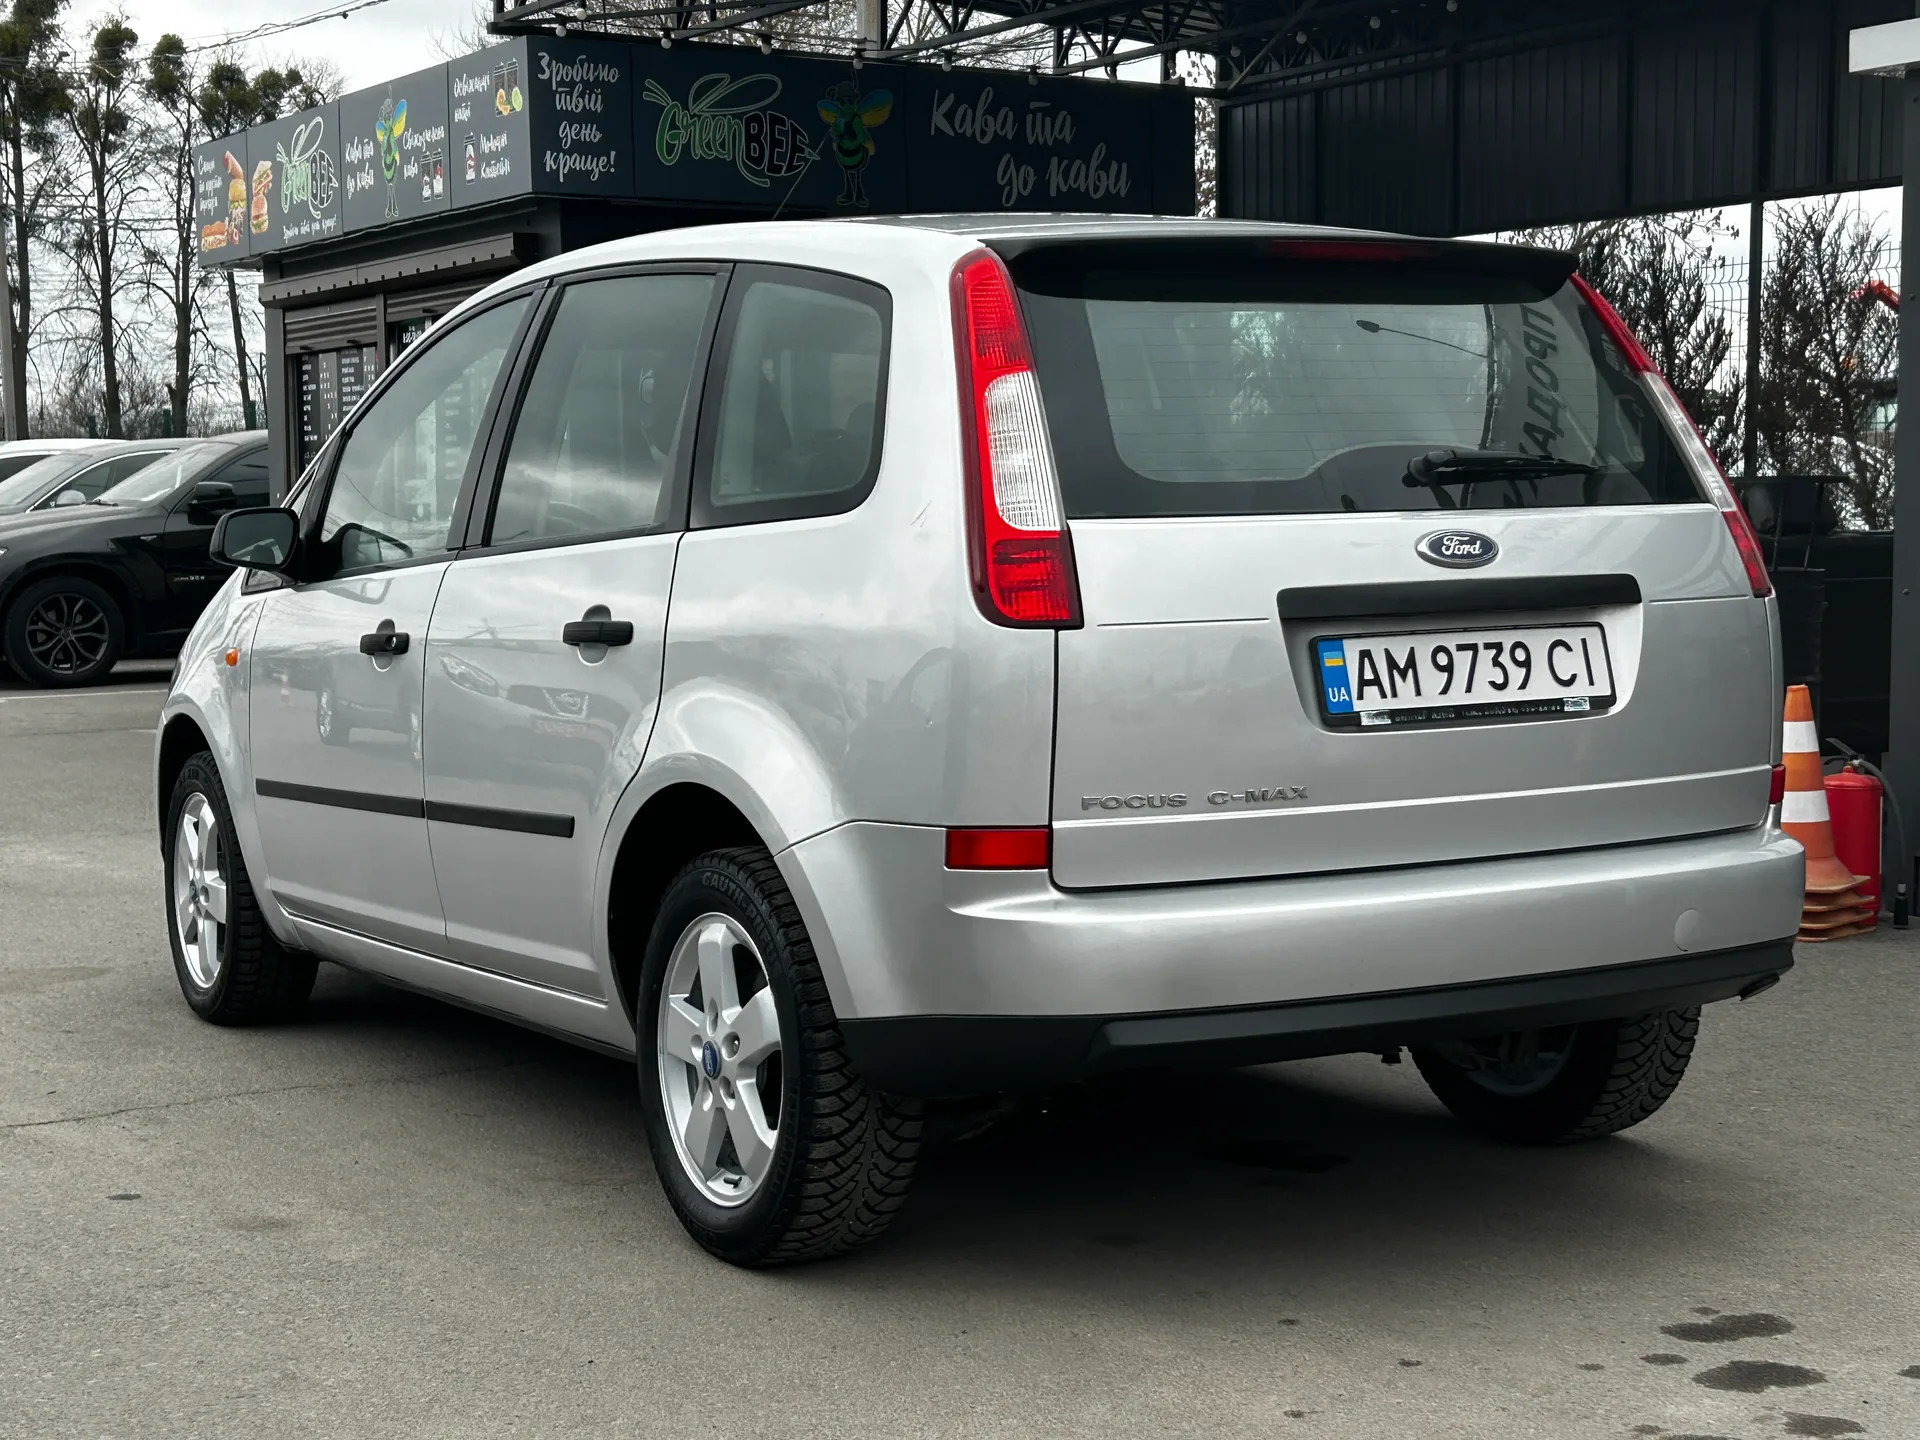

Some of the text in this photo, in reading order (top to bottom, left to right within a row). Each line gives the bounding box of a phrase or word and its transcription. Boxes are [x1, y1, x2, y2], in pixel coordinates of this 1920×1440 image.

[537, 51, 621, 91] Зробимо
[555, 83, 604, 113] твій
[930, 86, 1076, 146] Кава та
[558, 121, 603, 149] день
[543, 149, 617, 182] краще!
[996, 142, 1132, 207] до кави
[1441, 534, 1483, 557] Ford
[1355, 638, 1595, 701] AM 9739 CI
[1328, 686, 1349, 703] UA
[1081, 785, 1309, 811] FOCUS C-MAX
